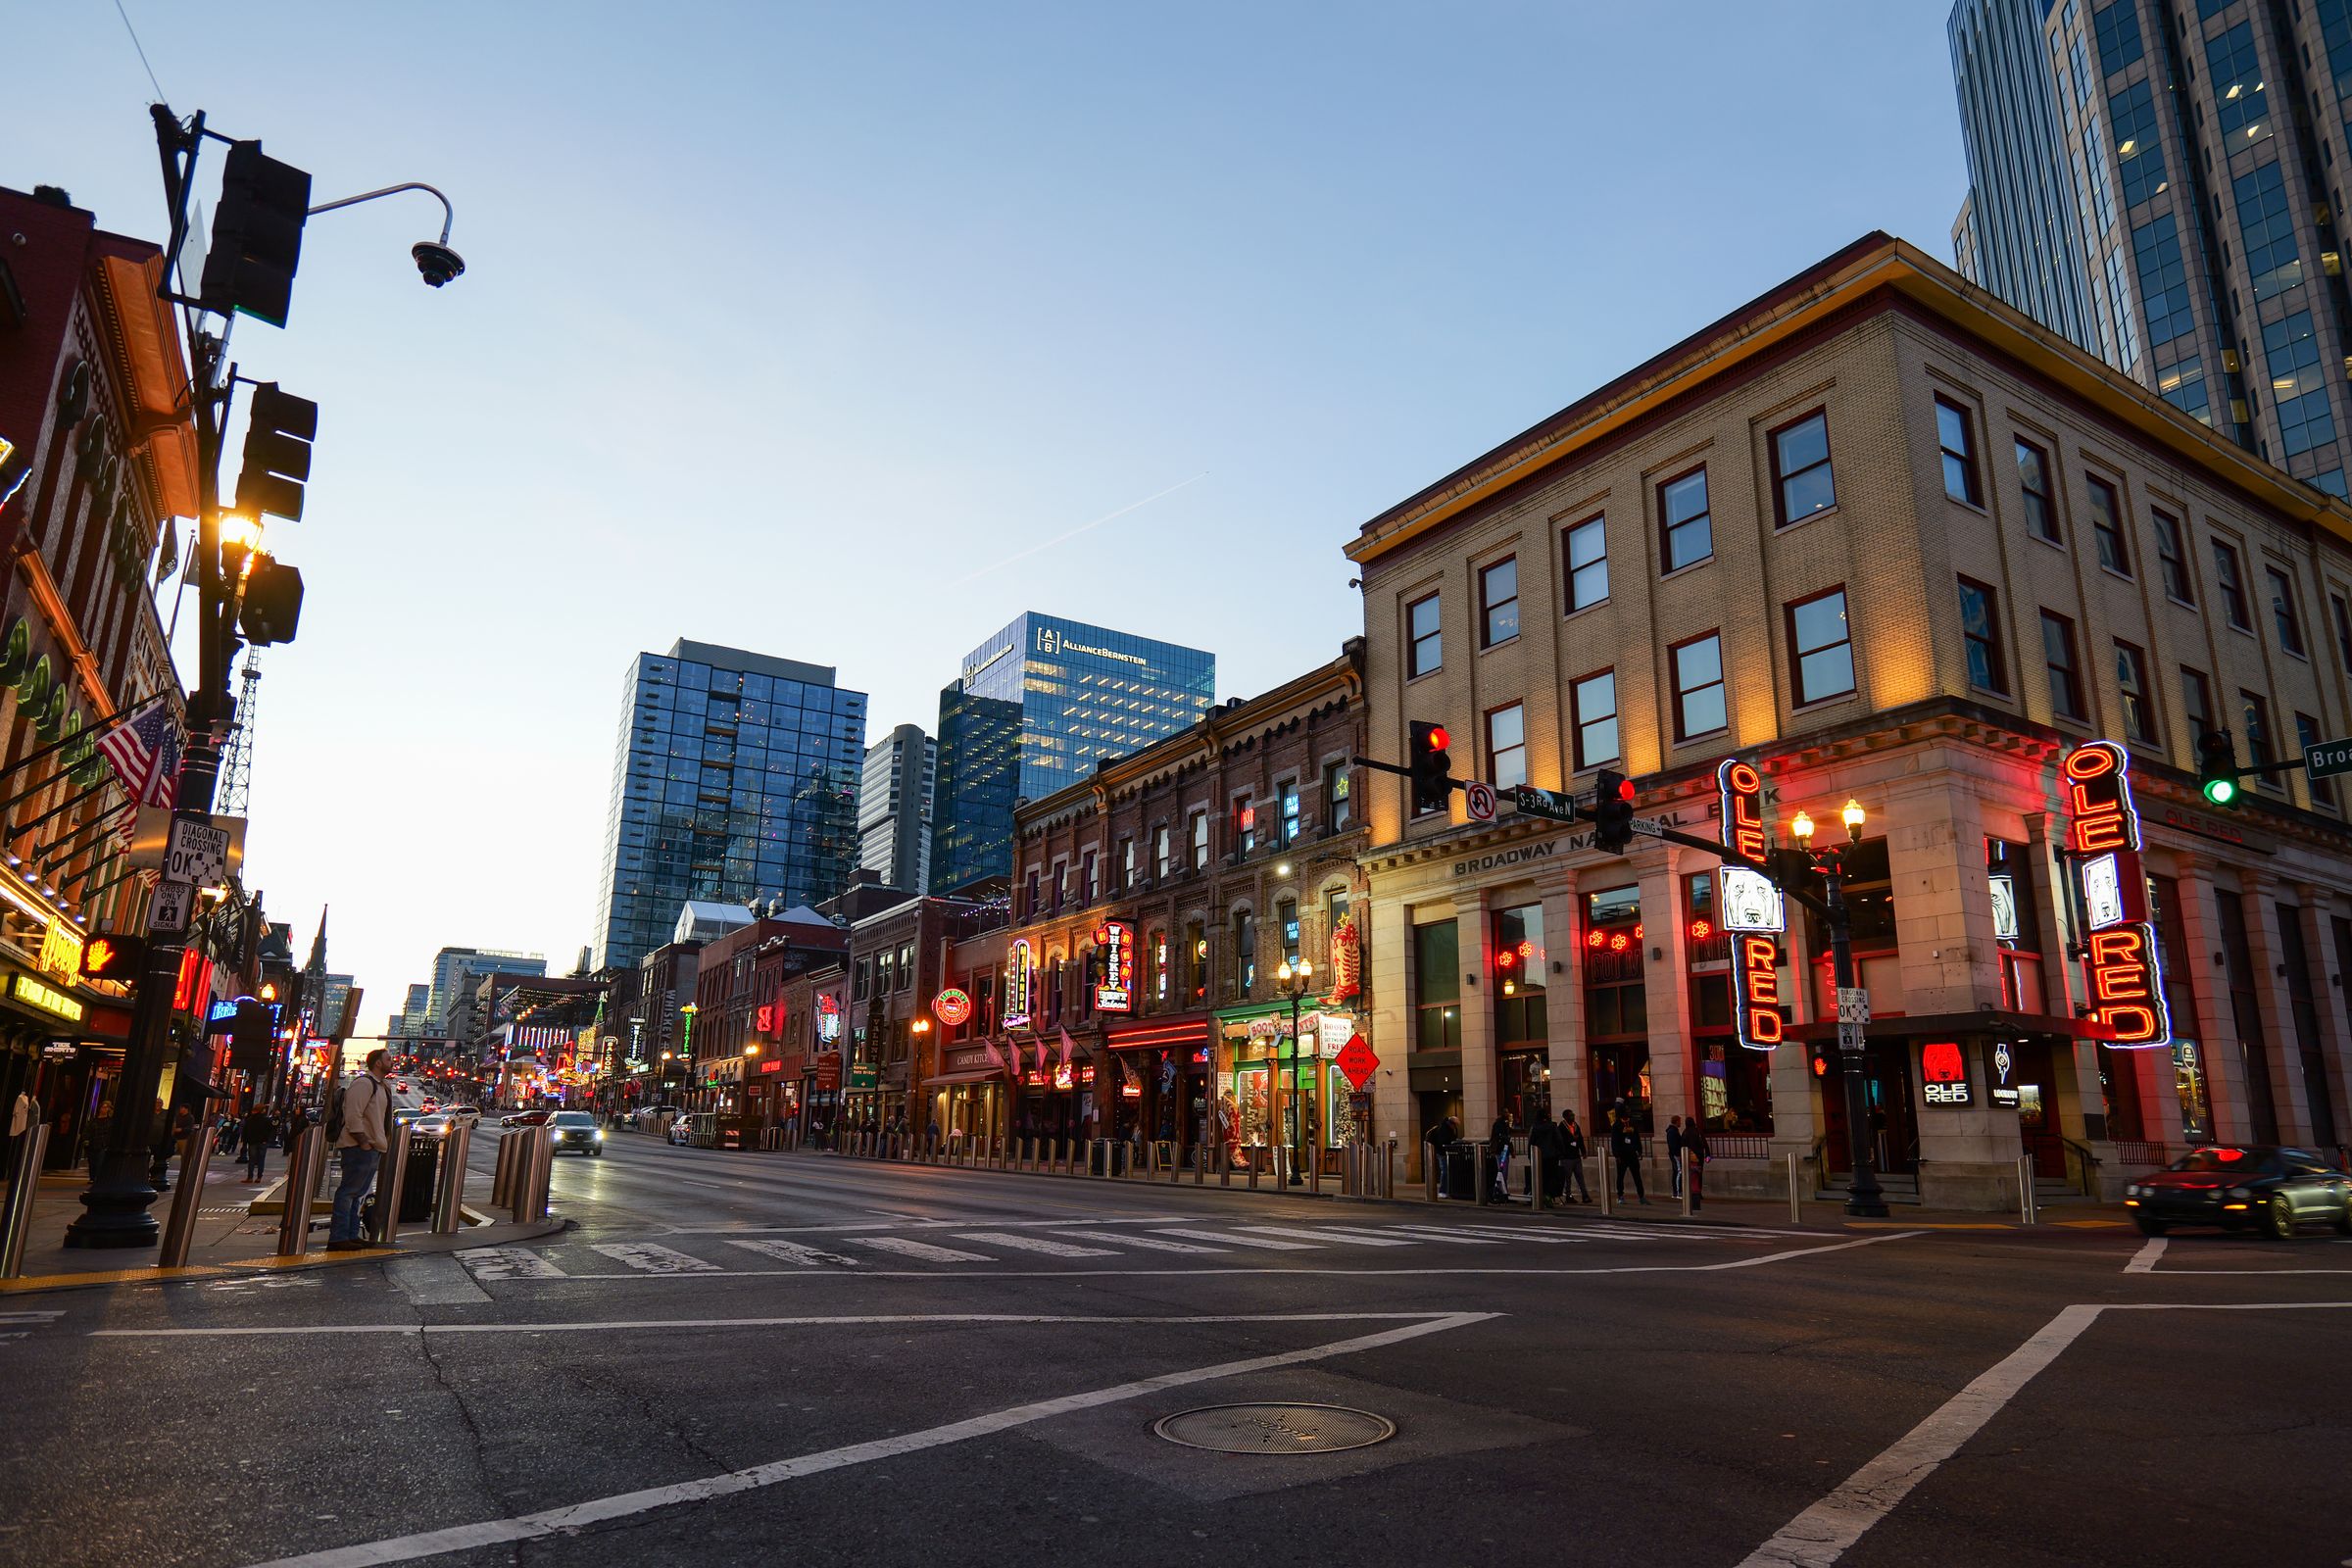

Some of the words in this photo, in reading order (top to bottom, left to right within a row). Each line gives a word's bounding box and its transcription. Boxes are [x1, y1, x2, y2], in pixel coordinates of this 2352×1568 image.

[1548, 802, 1564, 814] Ave
[1565, 802, 1571, 815] N
[2067, 748, 2124, 851] OLE
[1731, 764, 1766, 861] OLE
[182, 823, 223, 844] DIAGONAL
[1630, 820, 1656, 832] PARKING
[180, 836, 221, 856] CROSSING
[172, 851, 194, 875] OK
[1454, 841, 1556, 876] BROADWAY
[160, 885, 185, 894] CROSS
[161, 891, 183, 901] ONLY
[1108, 925, 1121, 991] WHISKEY
[1745, 939, 1782, 1042] RED
[2090, 932, 2154, 1040] RED
[661, 990, 676, 1042] WHISKEY
[1839, 1004, 1852, 1017] OK
[1251, 1022, 1274, 1036] BOOT
[1282, 1012, 1320, 1034] CONTRY
[956, 1054, 974, 1065] CANDY
[974, 1054, 989, 1064] KITC
[1924, 1083, 1967, 1094] OLE
[1925, 1093, 1969, 1102] RED
